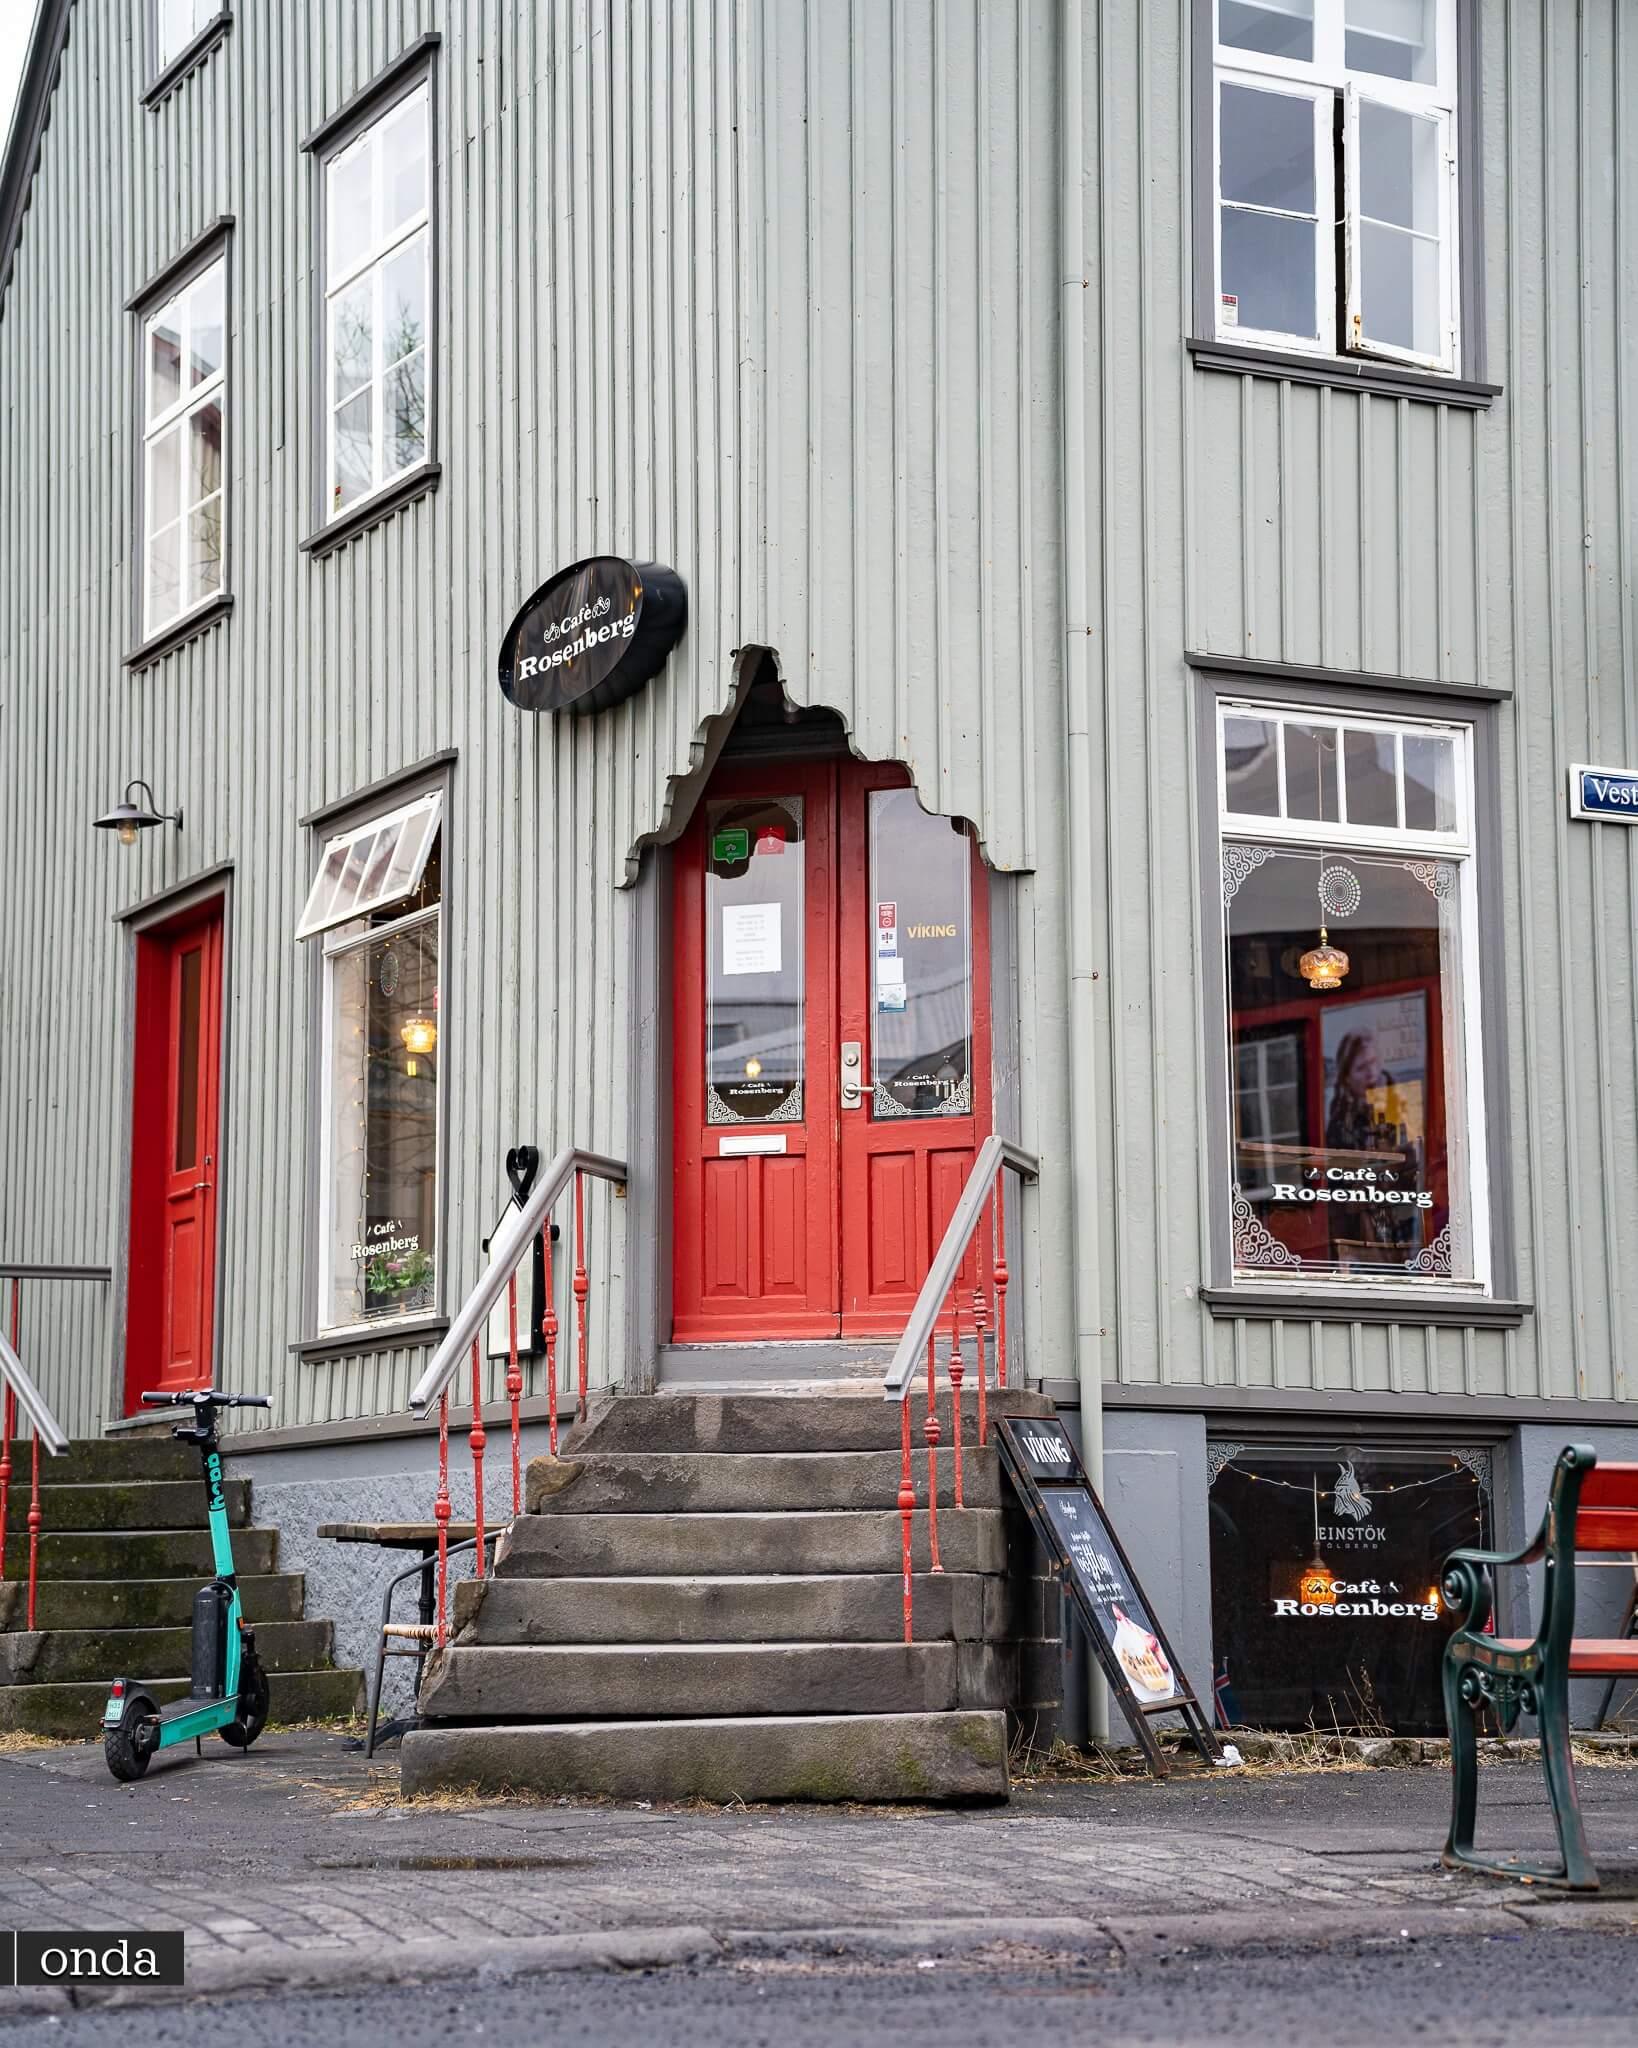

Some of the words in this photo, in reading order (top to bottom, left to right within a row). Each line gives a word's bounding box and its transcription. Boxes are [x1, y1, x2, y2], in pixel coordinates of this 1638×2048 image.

[519, 611, 636, 681] Rosenberg
[907, 923, 957, 939] VÍKING
[1272, 1183, 1434, 1208] Rosenberg
[351, 1234, 419, 1259] Rosenberg
[1022, 1431, 1071, 1463] VÍKING
[1318, 1524, 1387, 1541] EINSTÖK
[1273, 1599, 1439, 1621] Rosenberg
